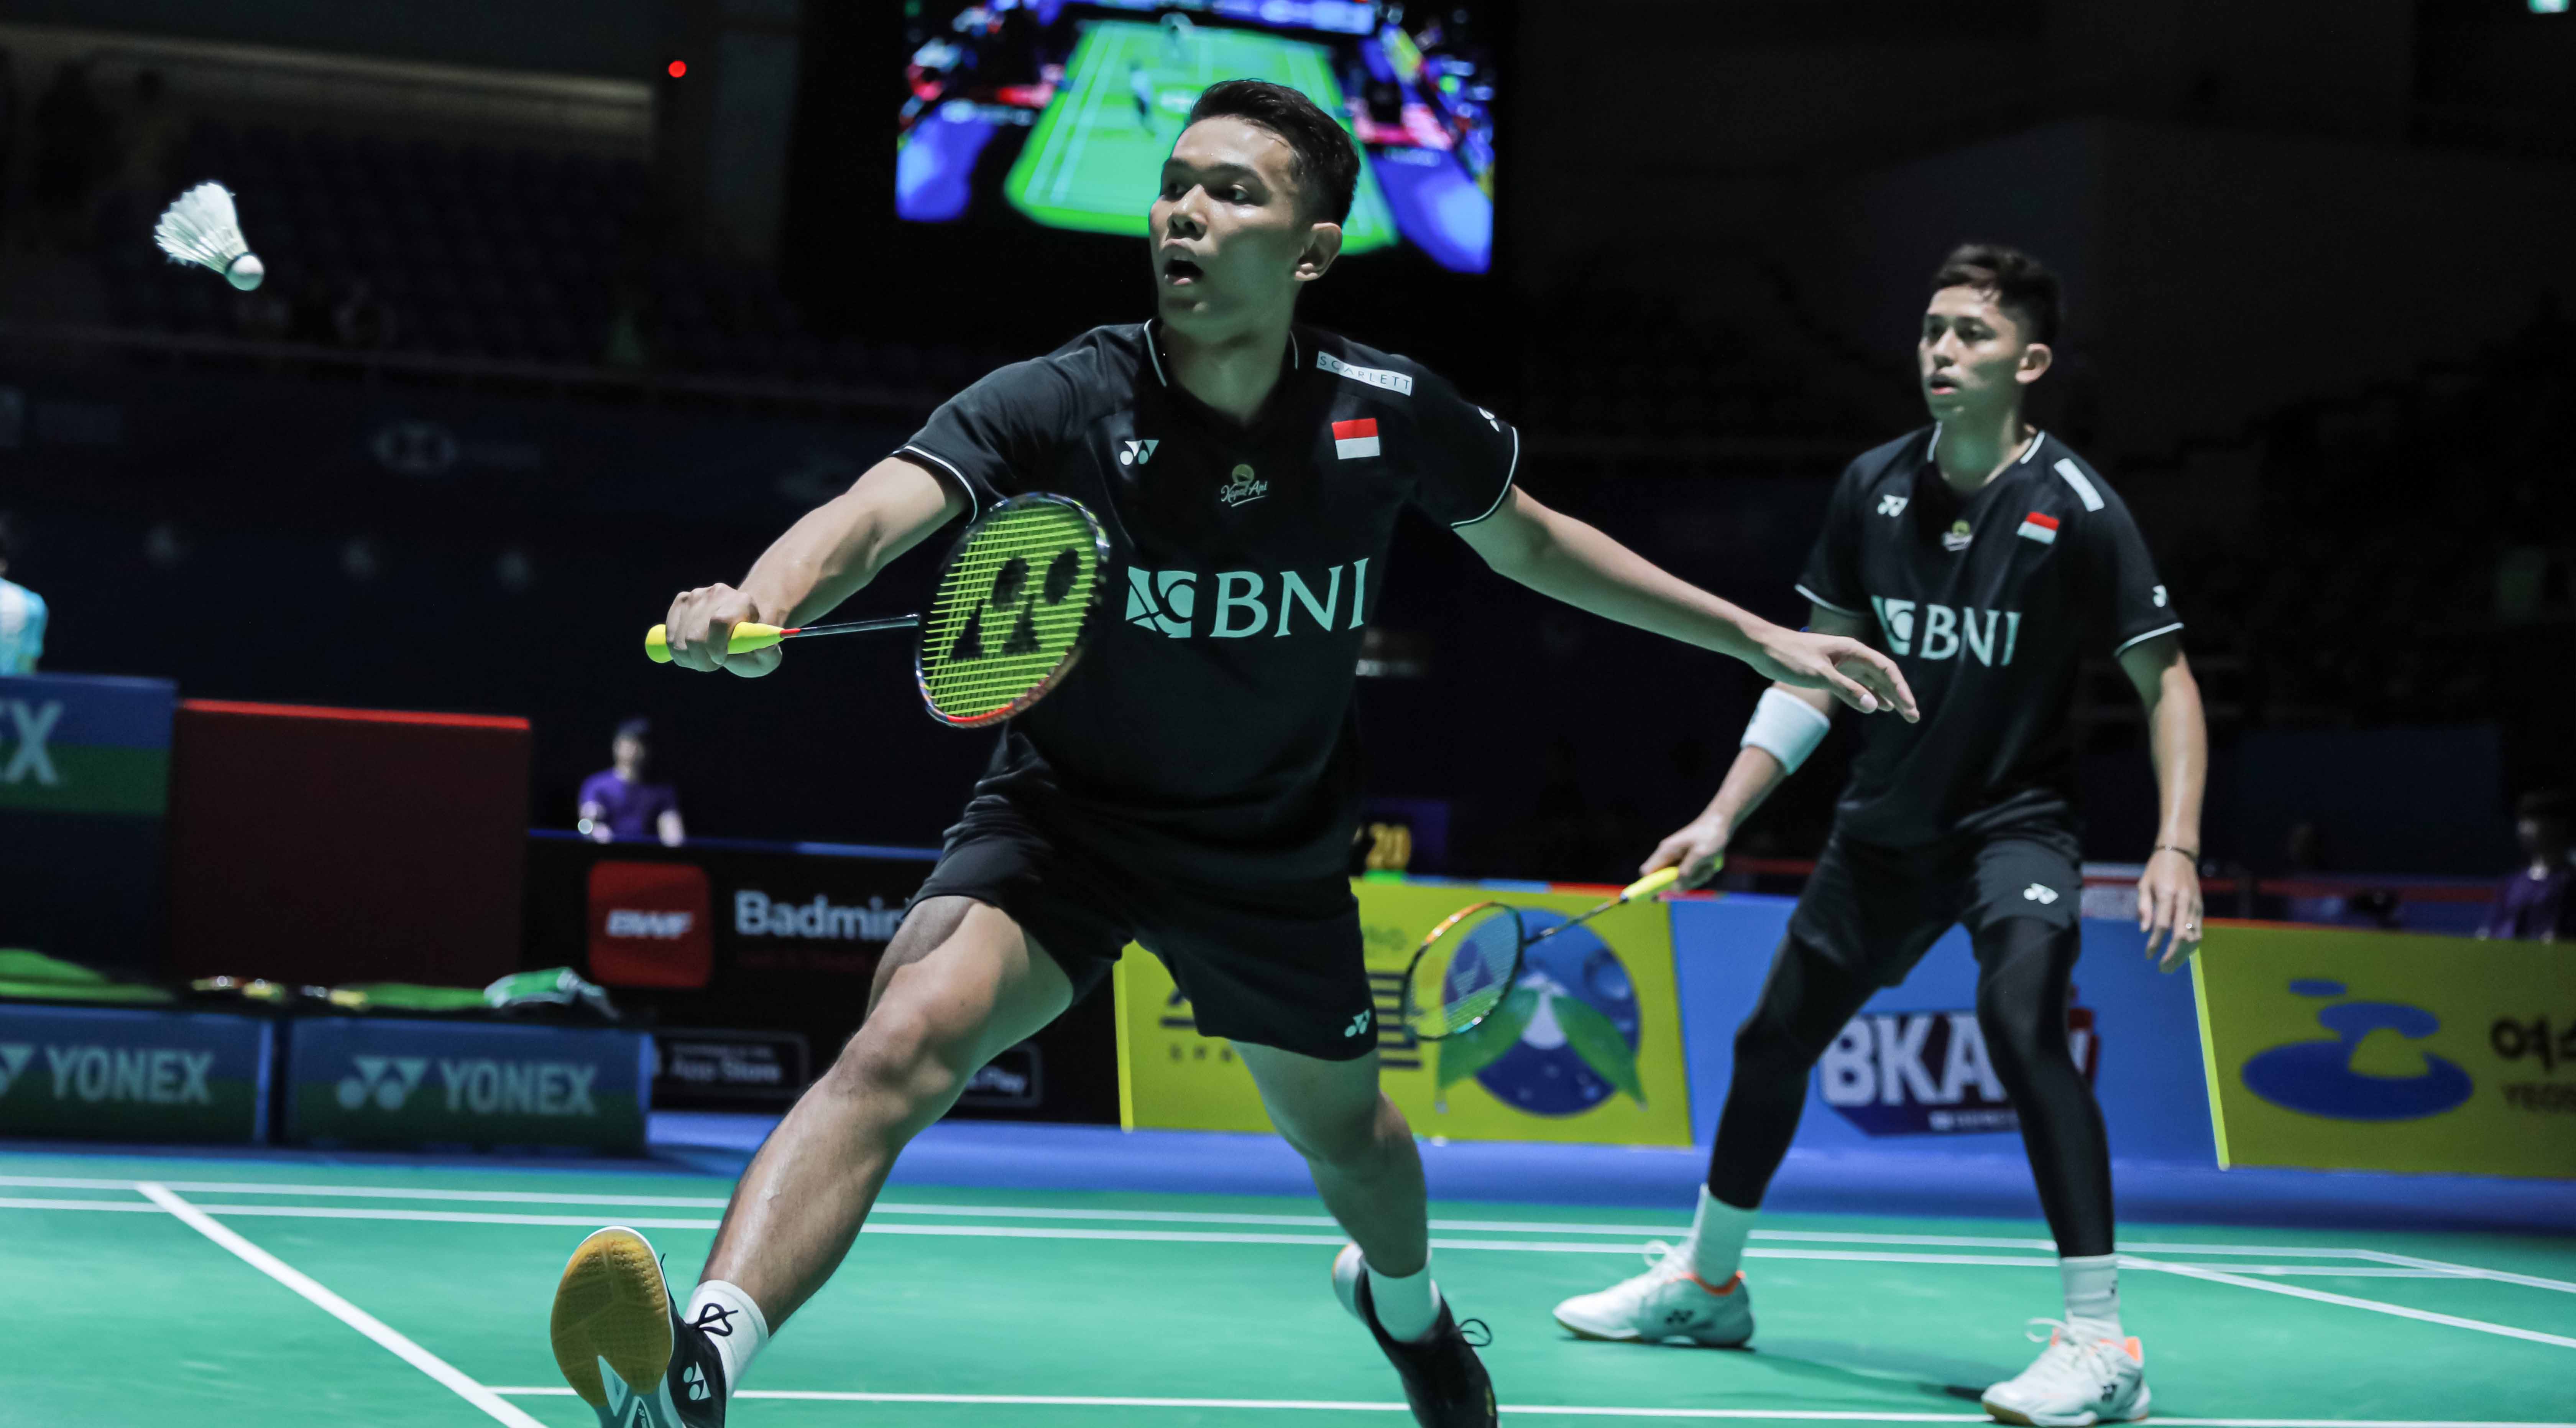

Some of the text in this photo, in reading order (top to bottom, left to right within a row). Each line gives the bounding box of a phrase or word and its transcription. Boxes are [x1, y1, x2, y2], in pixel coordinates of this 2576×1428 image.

[1320, 356, 1410, 390] SCARLETT
[1209, 558, 1370, 638] BNI
[1919, 603, 2022, 667] BNI
[0, 697, 63, 787] X
[45, 1045, 213, 1106] YONEX
[440, 1058, 599, 1117] YONEX
